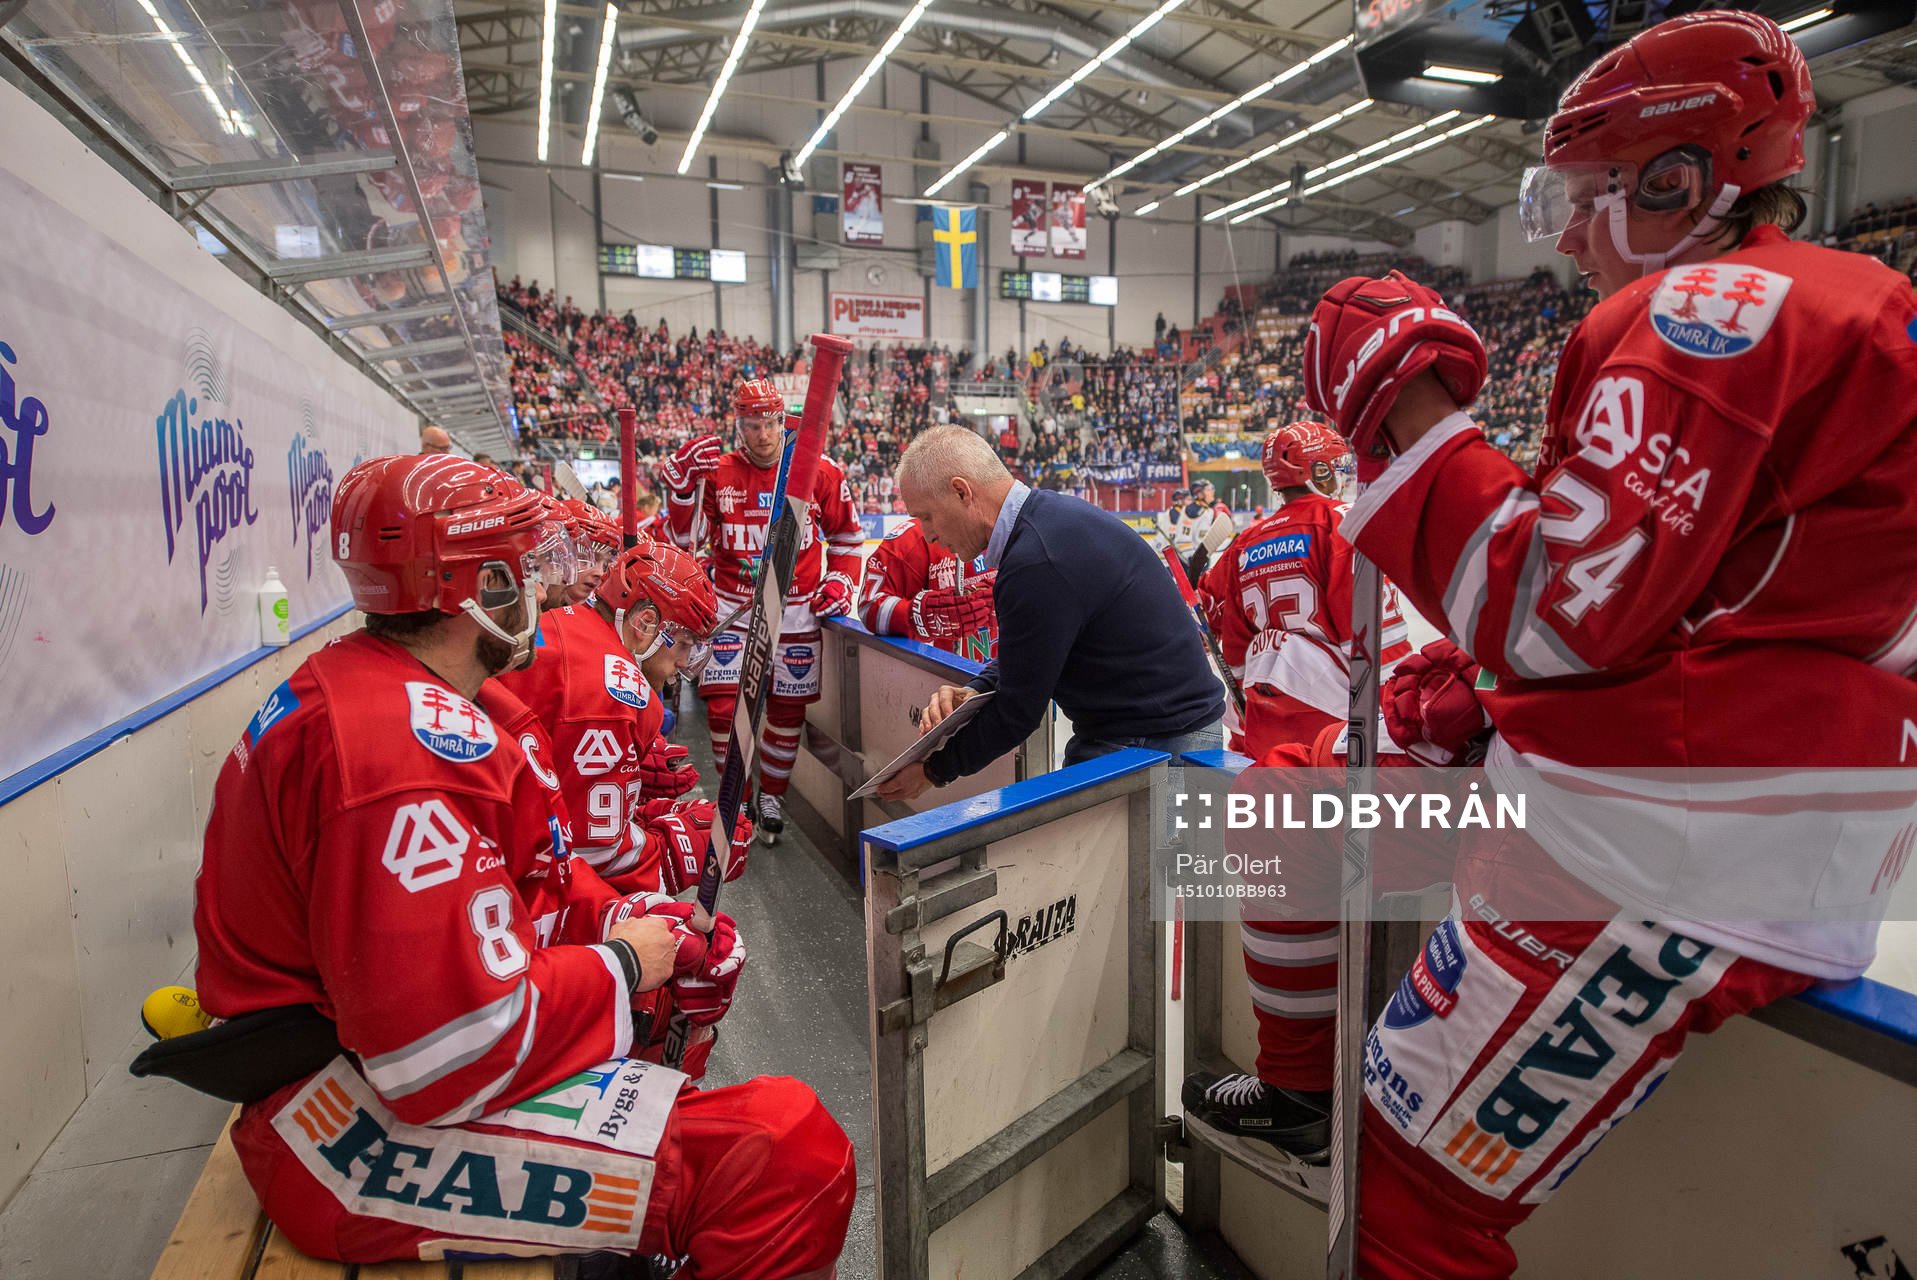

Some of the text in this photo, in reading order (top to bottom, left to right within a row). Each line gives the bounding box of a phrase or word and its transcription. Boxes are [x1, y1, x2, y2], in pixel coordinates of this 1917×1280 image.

[1639, 94, 1717, 119] BAUER
[1665, 322, 1730, 353] TIMRÅ IK
[447, 516, 505, 535] BAUER
[338, 532, 350, 560] 8
[1249, 539, 1306, 563] CORVARA
[428, 733, 478, 757] TIMRÅ IK
[466, 883, 531, 982] 8
[1469, 893, 1574, 970] BAUER
[1417, 976, 1453, 1012] PRINT
[597, 1087, 640, 1141] Bygg
[622, 1072, 644, 1085] &
